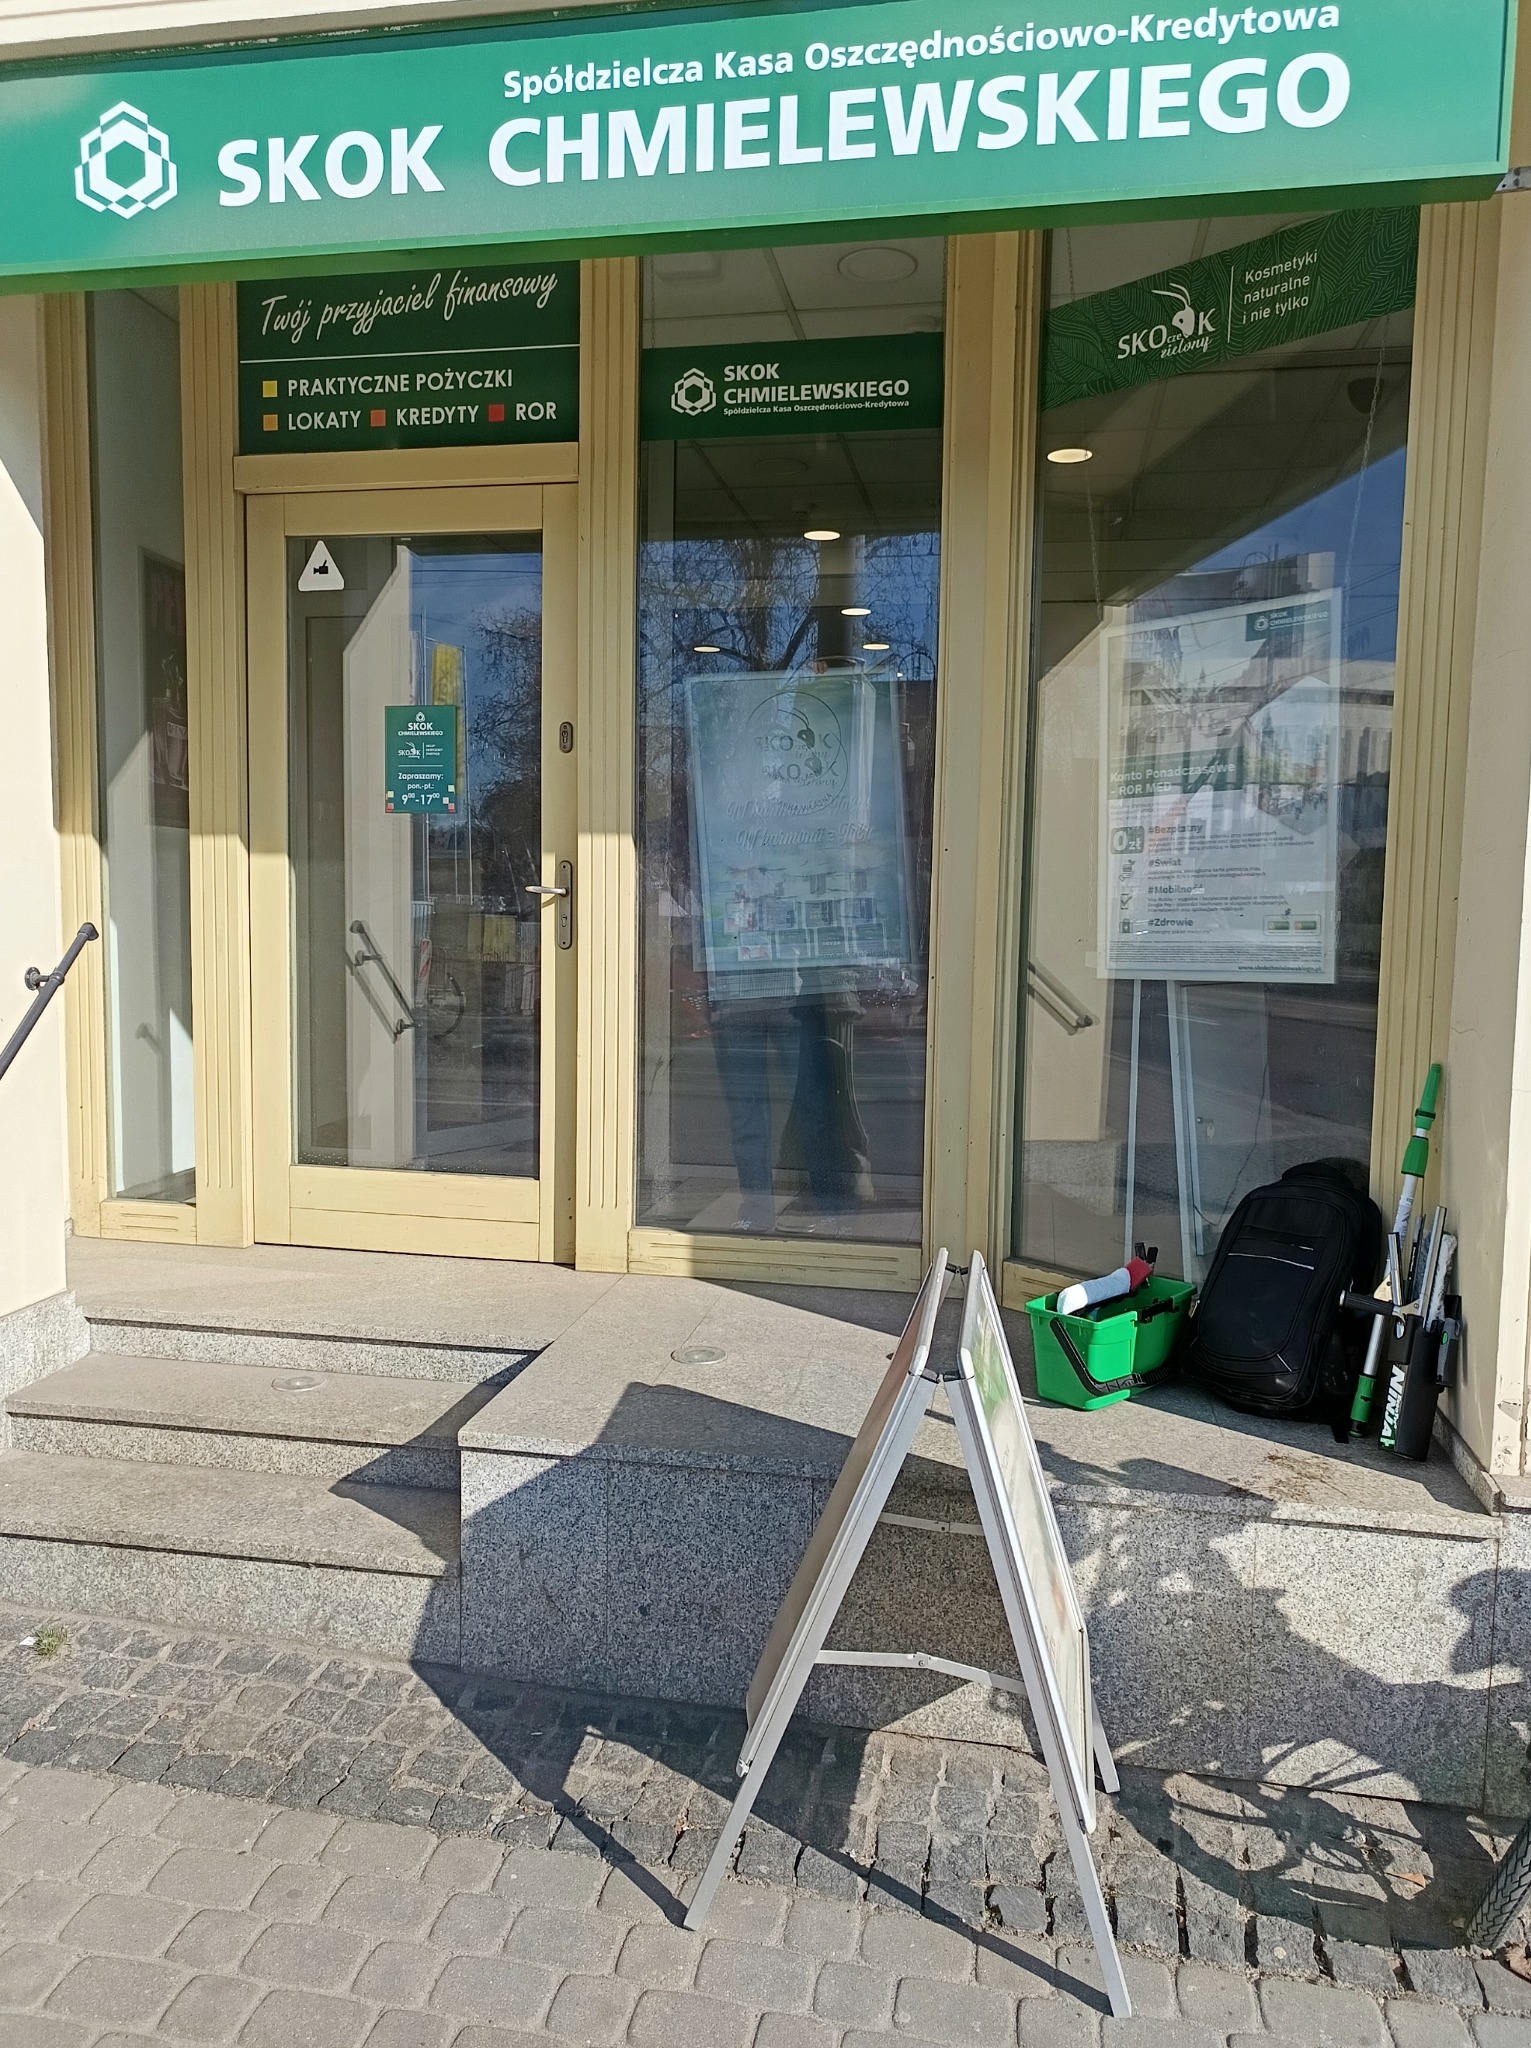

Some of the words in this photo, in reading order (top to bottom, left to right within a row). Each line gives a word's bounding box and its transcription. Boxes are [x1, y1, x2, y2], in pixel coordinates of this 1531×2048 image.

[504, 57, 703, 103] Spółdzielcza
[715, 51, 794, 80] Kasa
[805, 5, 1340, 68] Oszczędnościowo-Kredytowa
[217, 125, 446, 207] SKOK
[488, 53, 1350, 187] CHMIELEWSKIEGO
[1245, 249, 1318, 284] Kosmetyki
[1244, 275, 1310, 304] naturalne
[262, 294, 312, 344] Twój
[316, 272, 441, 340] przyjaciel
[443, 270, 558, 321] finansowy
[1242, 311, 1247, 325] i
[1250, 305, 1271, 323] nie
[1275, 297, 1309, 317] tylko
[288, 374, 410, 397] PRAKTYCZNE
[416, 368, 513, 392] POŻYCZKI
[723, 363, 780, 382] SKOK
[723, 379, 910, 405] CHMIELEWSKIEGO
[288, 411, 361, 431] LOKATY
[396, 405, 479, 426] KREDYTY
[515, 402, 557, 421] ROR
[723, 406, 771, 417] Spółdzielcza
[773, 404, 792, 413] Kasa
[794, 400, 910, 412] Oszczędnościowo-Kredytowa
[407, 722, 433, 731] SKOK
[397, 772, 444, 781] Zapraszamy:
[1110, 772, 1142, 783] Konto
[1146, 762, 1236, 780] Ponadczasowe
[1120, 784, 1142, 796] ROR
[1146, 781, 1172, 793] MED
[1148, 823, 1203, 835] #Bezpłatny
[1148, 858, 1182, 867] #Świat
[1148, 918, 1193, 927] #Zdrowie
[1381, 1364, 1406, 1437] NINJA
